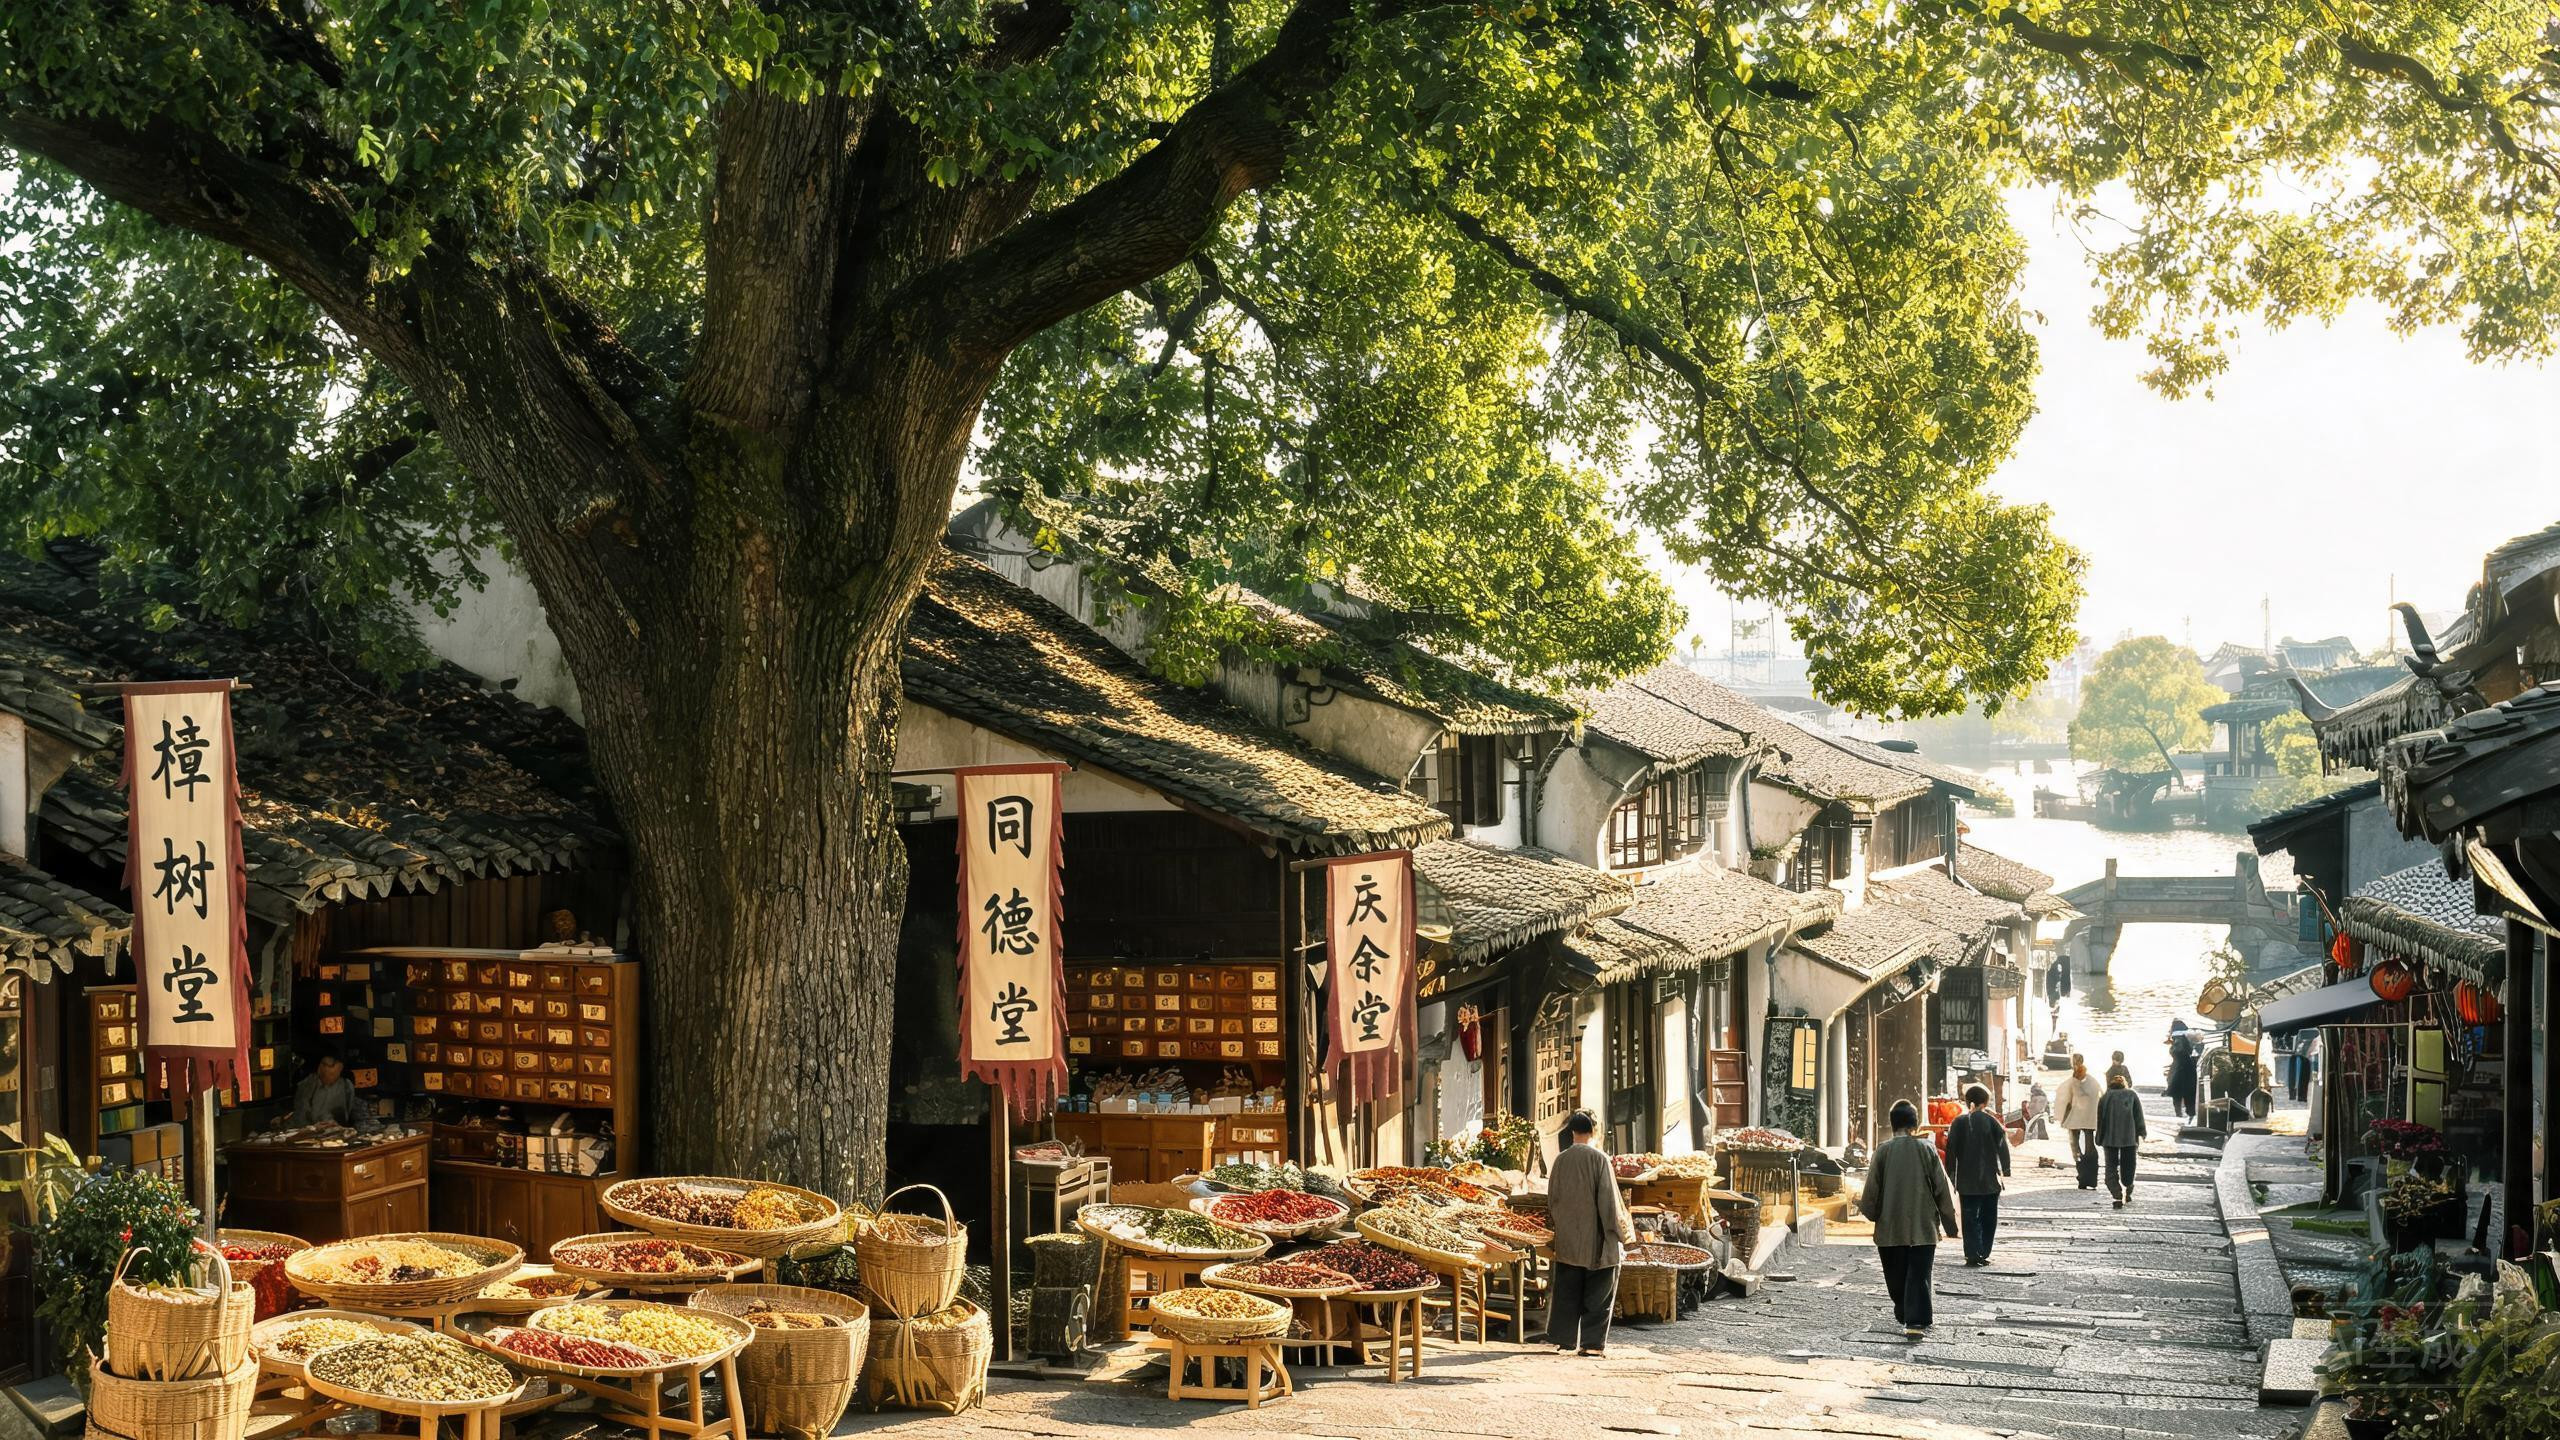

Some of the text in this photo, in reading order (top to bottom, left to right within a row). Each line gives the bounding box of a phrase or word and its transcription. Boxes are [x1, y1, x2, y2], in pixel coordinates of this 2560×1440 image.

[151, 715, 218, 1023] 樟树堂
[982, 795, 1040, 1046] 同德堂
[1347, 875, 1391, 1042] 庆余堂
